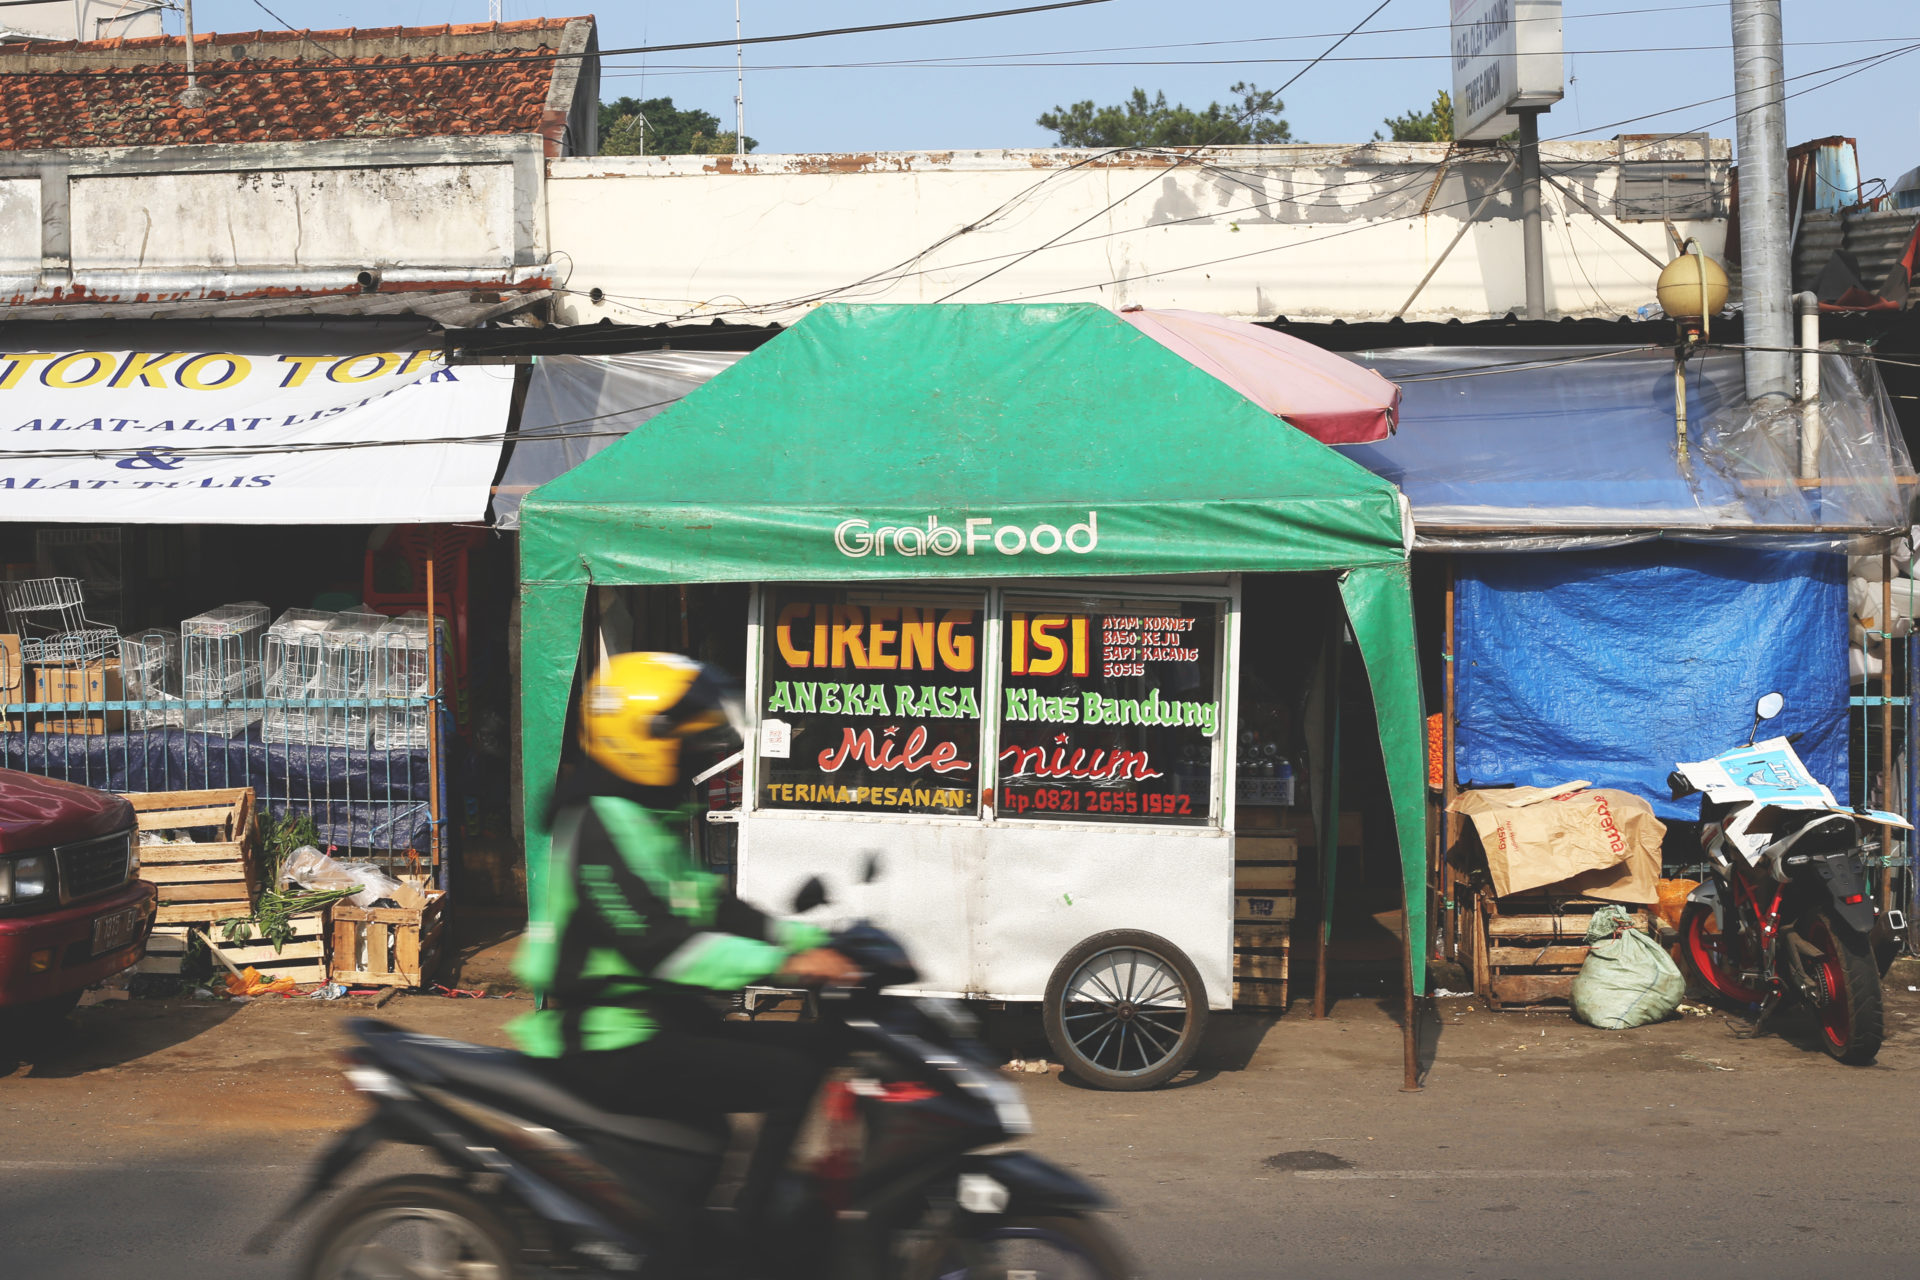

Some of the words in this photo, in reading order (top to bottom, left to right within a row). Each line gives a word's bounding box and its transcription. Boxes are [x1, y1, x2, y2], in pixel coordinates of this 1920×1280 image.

[0, 349, 252, 390] TOKO
[12, 418, 272, 432] ALAT-ALAT
[115, 445, 186, 471] &
[0, 477, 120, 489] ALAT
[1102, 616, 1140, 630] AYAM
[1143, 617, 1196, 632] KORNET
[776, 602, 975, 672] CIRENG
[1011, 612, 1090, 677] ISI
[1103, 630, 1138, 646] BASO
[1141, 632, 1181, 646] KEJU
[1103, 646, 1136, 661] SAPI
[1141, 647, 1199, 662] KACANG
[1103, 662, 1145, 677] SOSIS
[768, 681, 891, 716] ANEKA
[894, 684, 981, 719] RASA
[1005, 687, 1080, 722] Khas
[1081, 687, 1219, 737] Bandung
[817, 725, 972, 772] Mile
[999, 732, 1165, 782] nium
[767, 783, 851, 803] TERIMA
[857, 786, 972, 809] PESANAN:
[1141, 793, 1193, 815] 1992
[1496, 826, 1507, 851] 25kg
